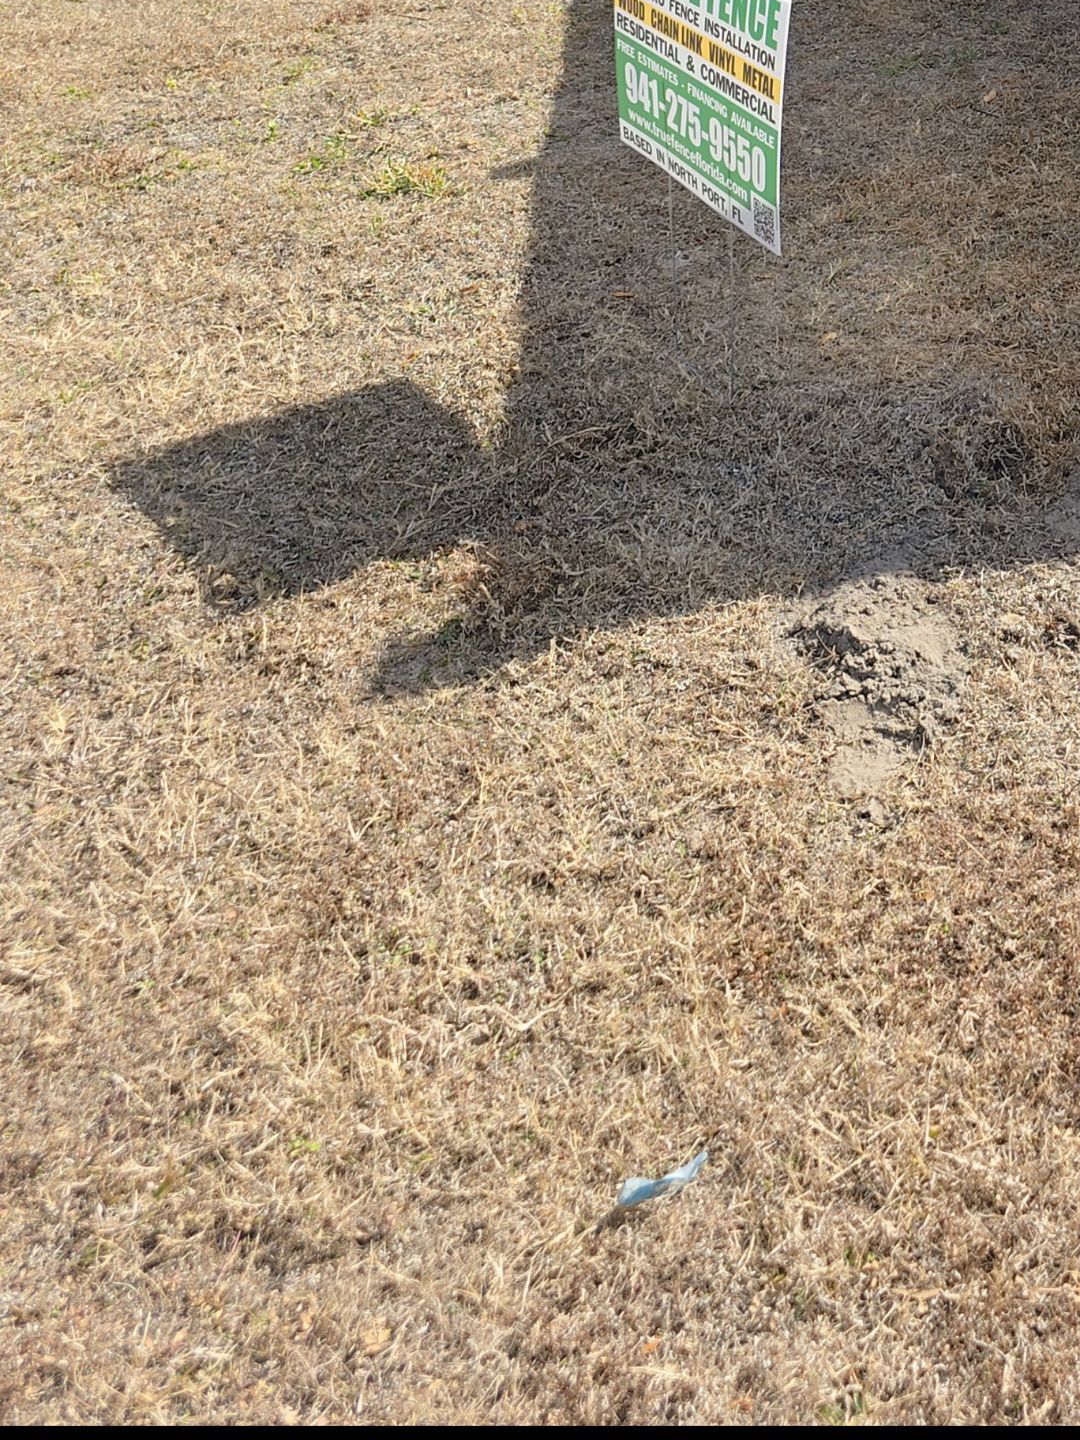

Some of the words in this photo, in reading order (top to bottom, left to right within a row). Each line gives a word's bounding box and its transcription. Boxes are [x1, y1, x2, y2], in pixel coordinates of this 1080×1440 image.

[617, 13, 681, 65] RESIDENTIAL
[686, 55, 695, 73] &
[700, 64, 775, 124] COMMERCIAL
[651, 9, 679, 42] CHAIN
[681, 27, 703, 56] LINK
[709, 42, 736, 76] VINYL
[743, 63, 774, 99] METAL
[704, 17, 775, 71] INSTALLATION
[617, 39, 635, 59] FREE
[638, 52, 679, 86] ESTIMATES
[687, 82, 728, 118] FINANCING
[730, 111, 775, 149] AVAILABLE
[624, 62, 766, 192] 941-275-9550
[623, 126, 652, 155] BASED
[656, 147, 666, 165] IN
[668, 156, 698, 190] NORTH
[702, 182, 728, 215] PORT,
[732, 205, 744, 225] FL
[628, 109, 748, 202] www.truefenceflorida.com
